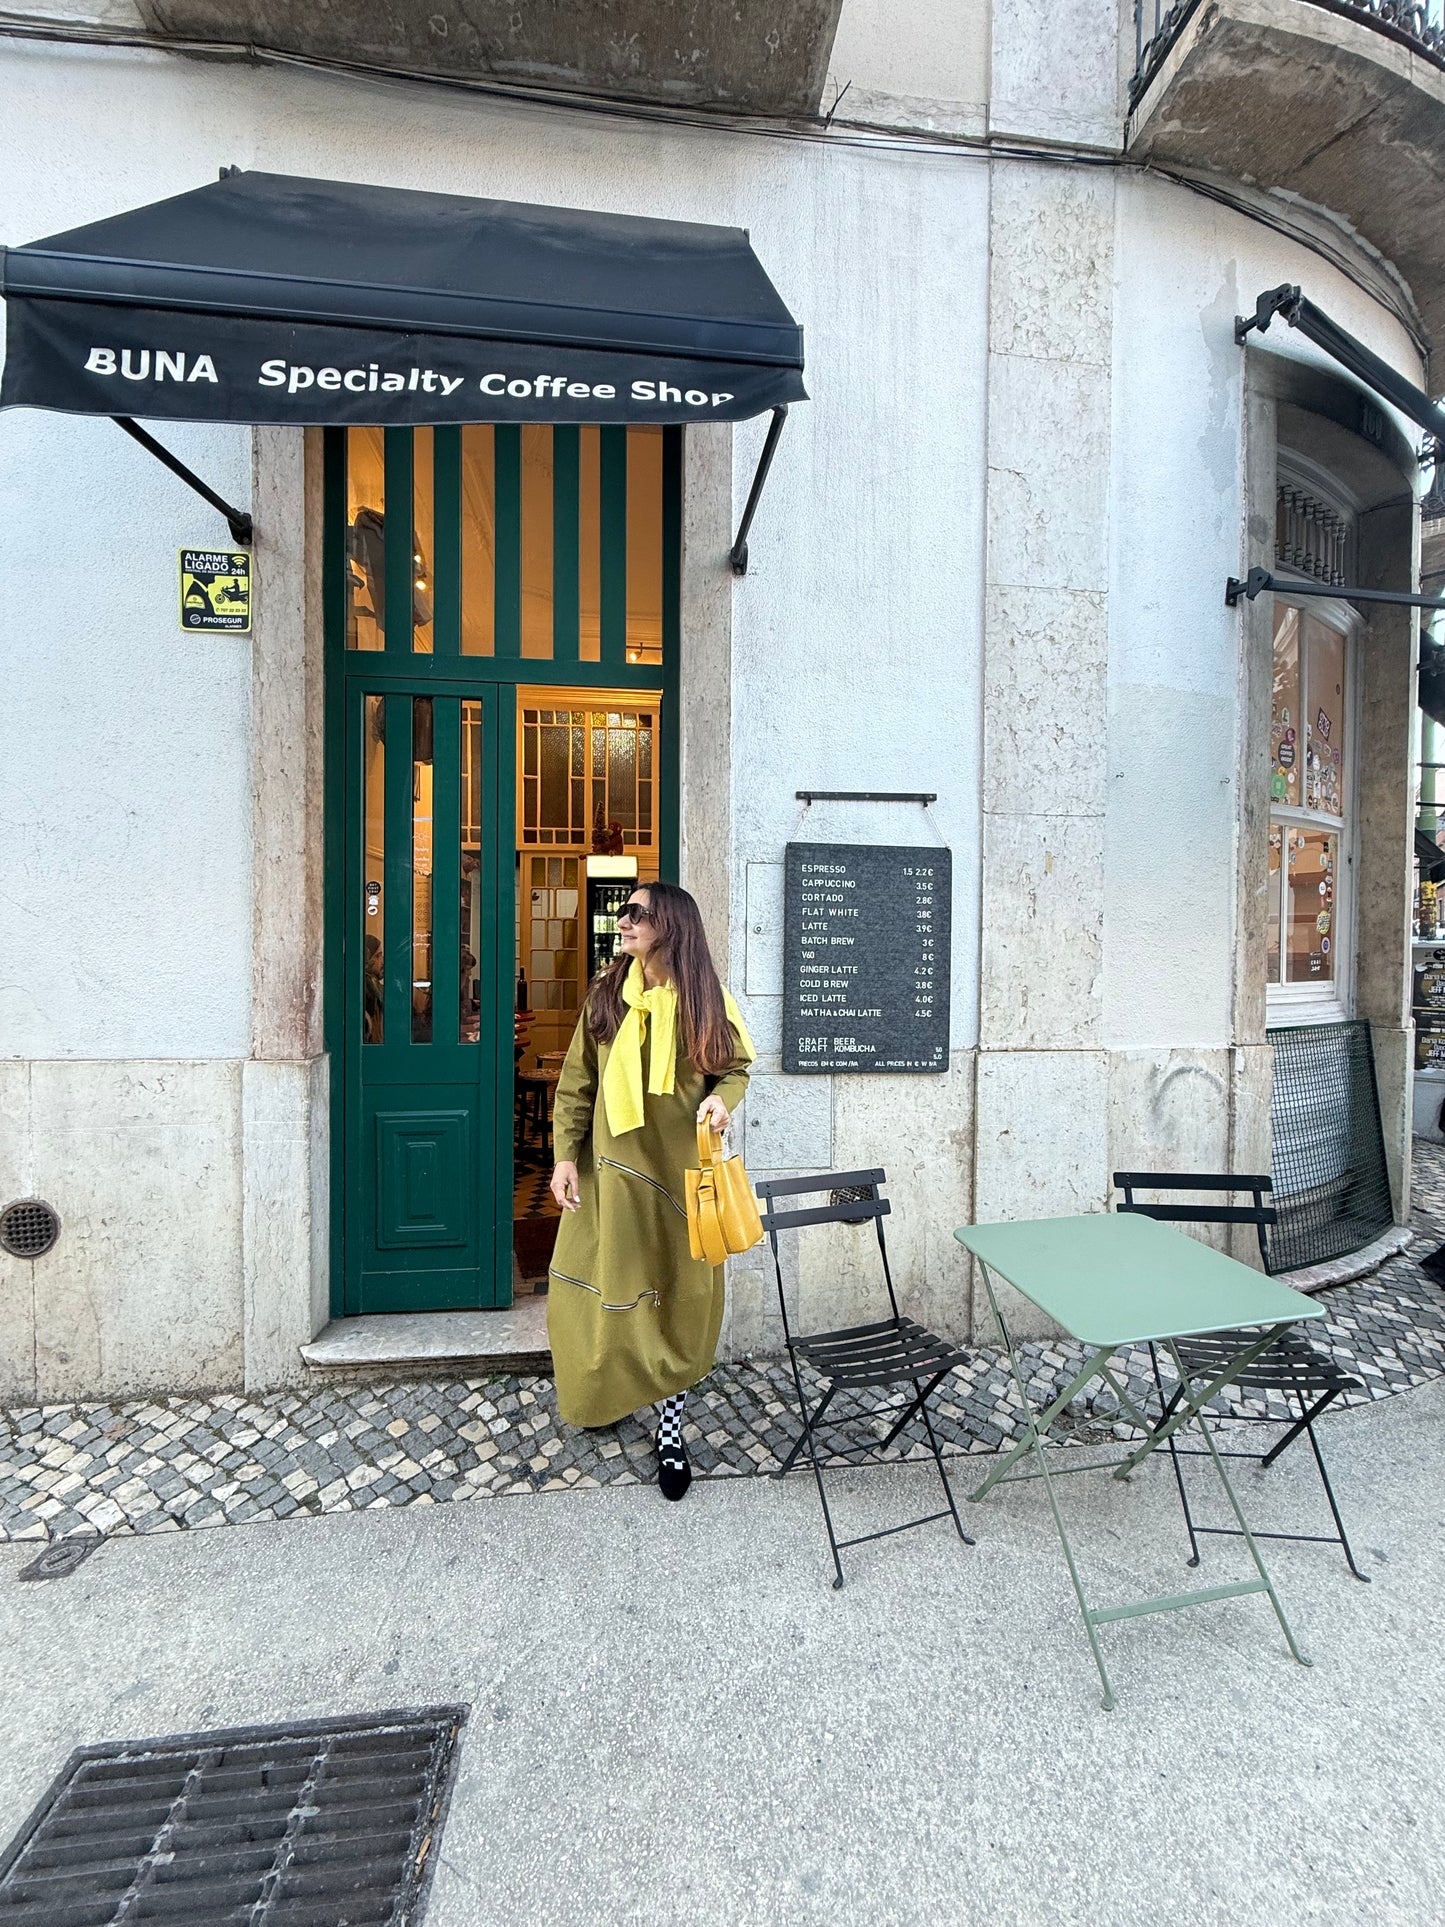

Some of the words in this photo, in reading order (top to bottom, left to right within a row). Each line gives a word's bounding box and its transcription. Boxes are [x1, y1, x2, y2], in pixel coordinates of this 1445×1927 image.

[84, 347, 219, 383] BUNA
[258, 359, 465, 396] Specialty
[479, 373, 616, 399] Coffee
[185, 553, 228, 562] ALARME
[185, 561, 228, 571] LIGADO
[802, 865, 846, 874] ESPRESSO
[802, 879, 856, 888] CAPPUCCINO
[916, 882, 934, 890] 3.5€
[802, 894, 844, 902] CORTADO
[916, 896, 932, 904] 2.8€
[802, 908, 824, 916] FLAT
[829, 908, 858, 916] WHITE
[802, 922, 828, 930] LATTE
[831, 937, 854, 946] BREW
